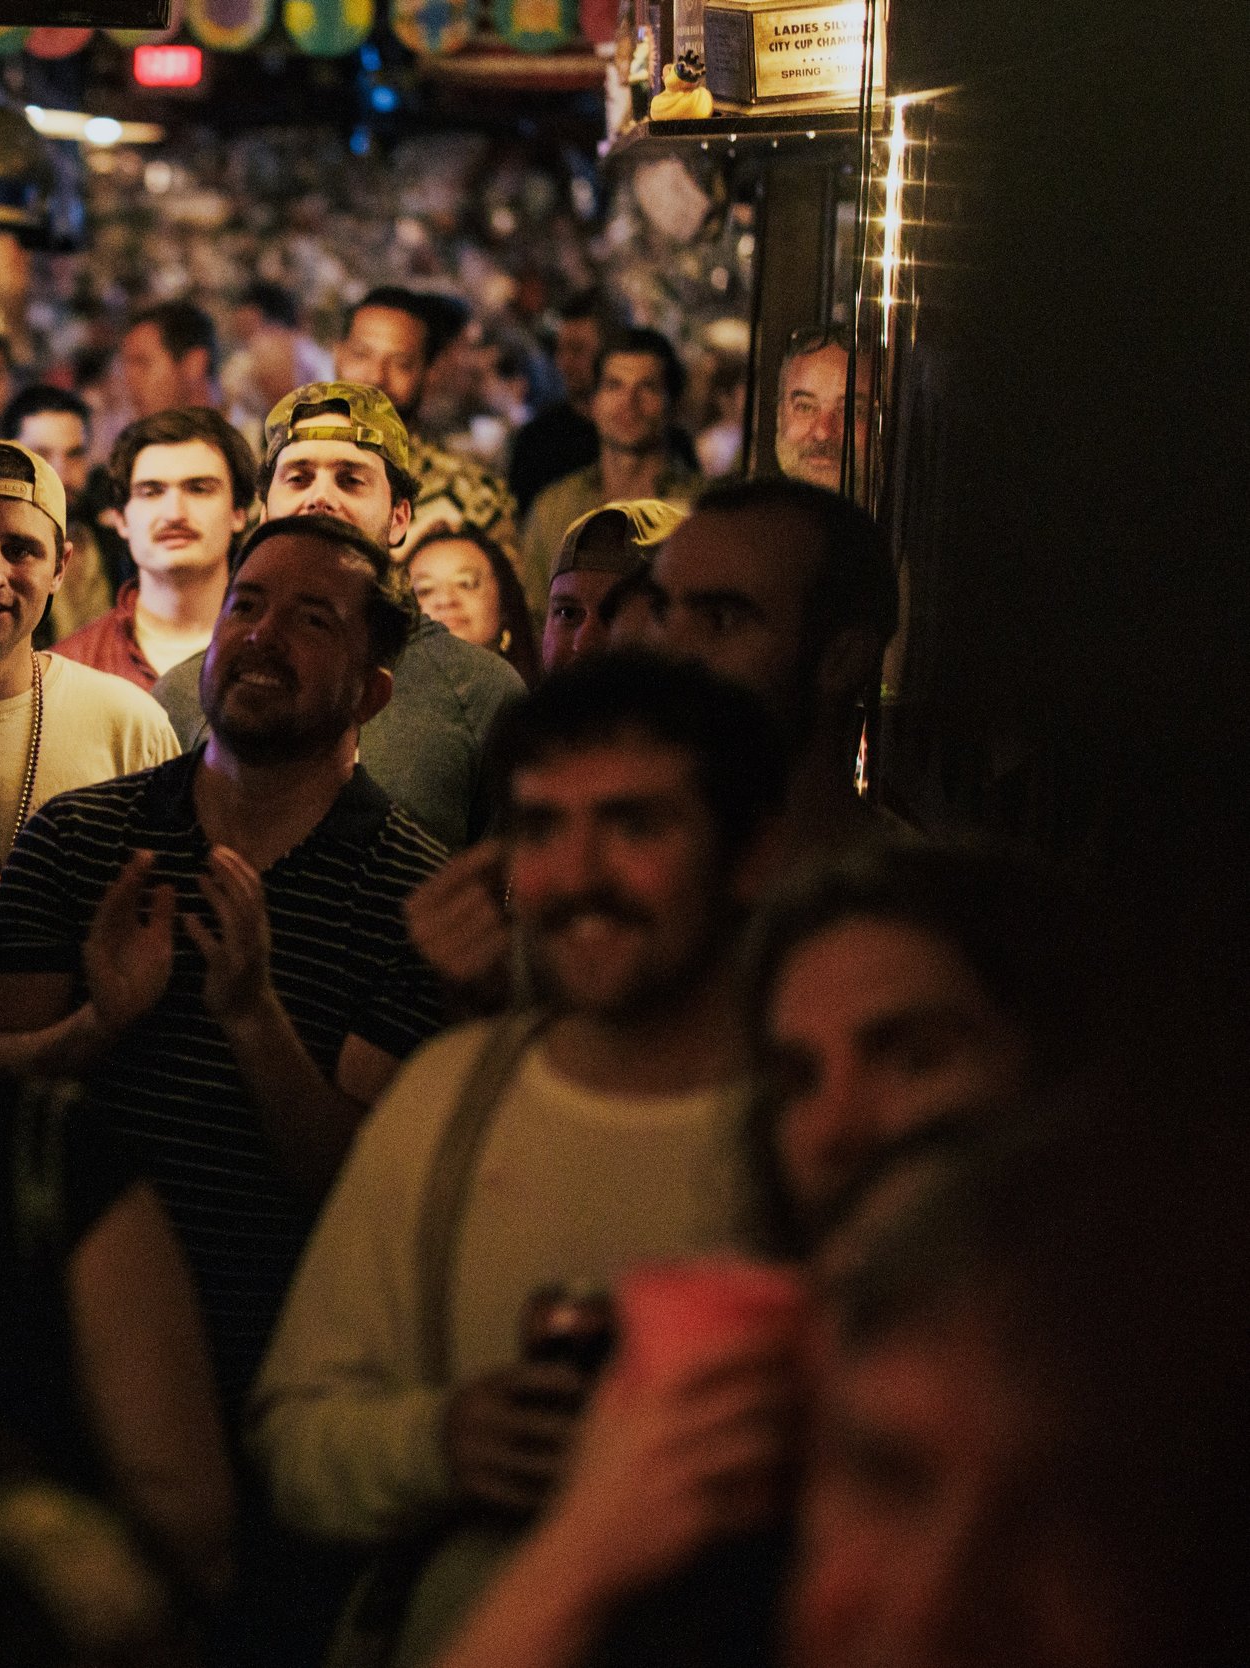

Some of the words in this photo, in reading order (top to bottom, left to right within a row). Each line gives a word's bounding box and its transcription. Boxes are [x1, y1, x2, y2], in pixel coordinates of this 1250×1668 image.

[774, 22, 819, 37] LADIES
[824, 20, 862, 32] SILV
[768, 40, 791, 53] CITY
[794, 38, 813, 50] CUP
[781, 67, 821, 79] SPRING
